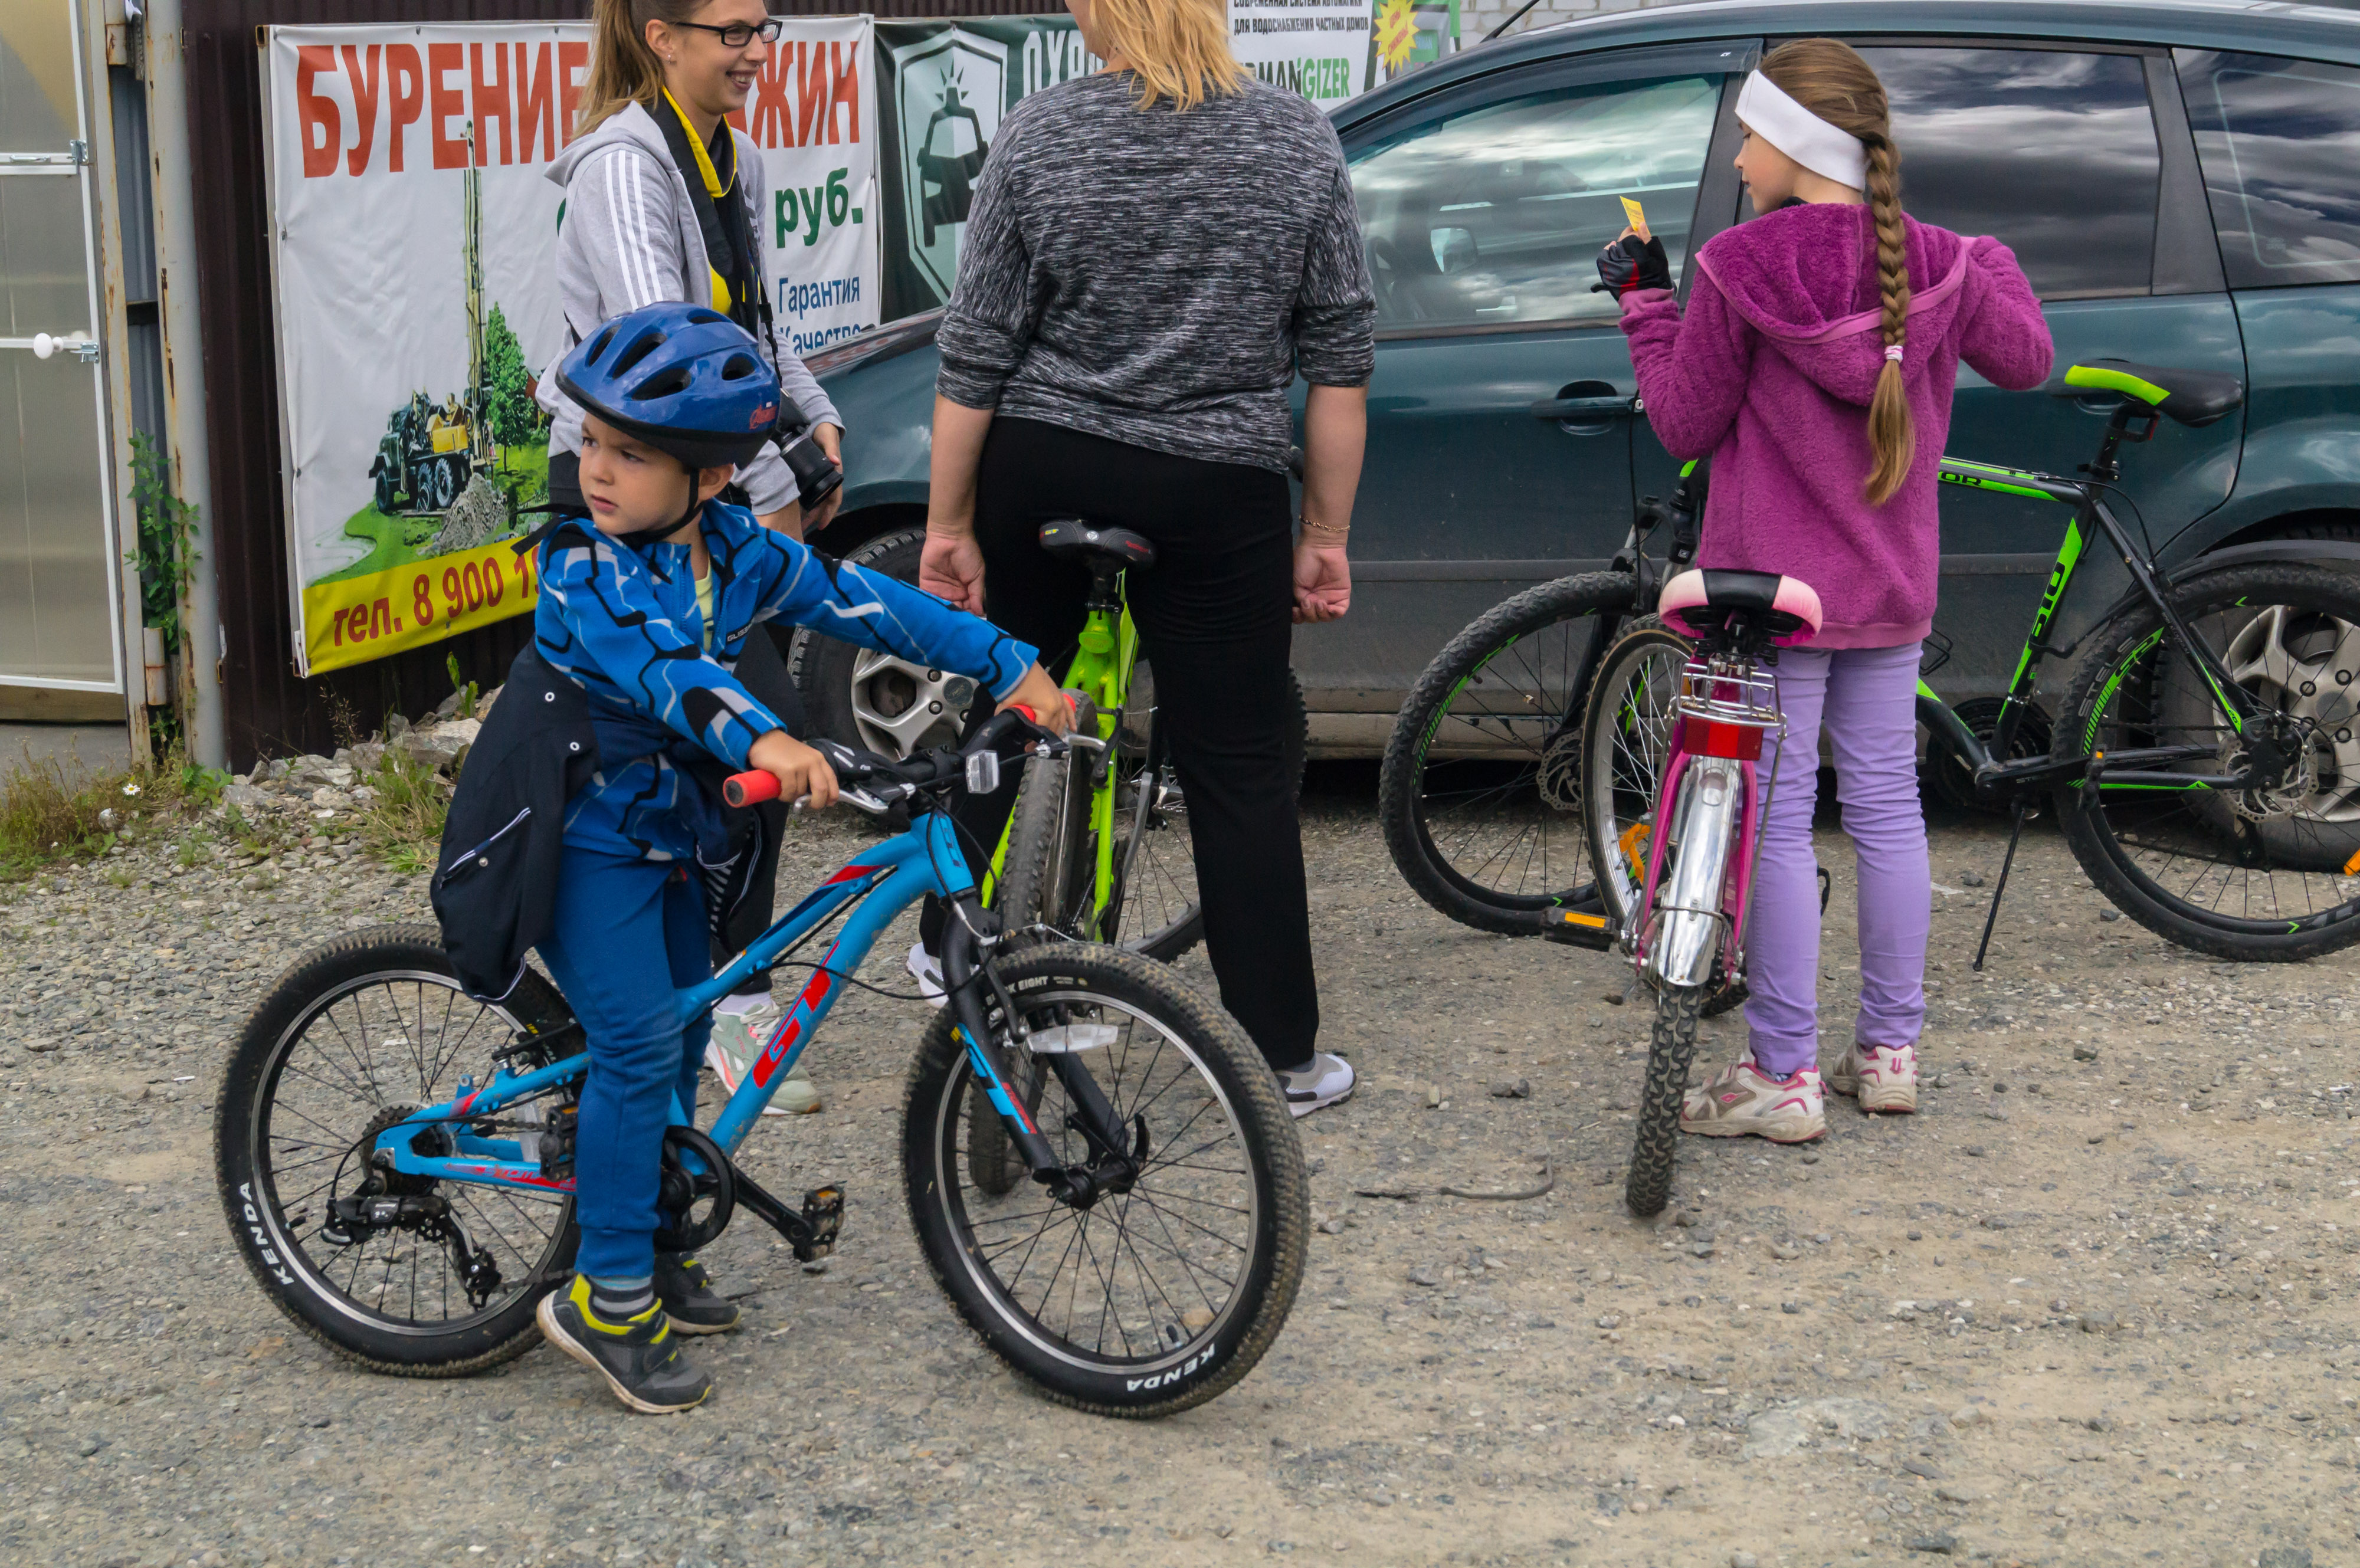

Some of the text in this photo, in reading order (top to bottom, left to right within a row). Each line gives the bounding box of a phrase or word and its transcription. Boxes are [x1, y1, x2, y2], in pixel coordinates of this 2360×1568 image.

[1023, 29, 1104, 99] ОХР
[1234, 17, 1369, 35] ДЛЯ ВОДОСНАБЖЕНИЯ ЧАСТНЫХ ДОМОВ
[296, 41, 589, 178] БУРЕНИЕ
[729, 40, 860, 149] ЖИН
[775, 168, 863, 249] руб.
[779, 276, 860, 320] Гарантия
[333, 597, 404, 647] тел.
[413, 574, 434, 626] 8
[442, 556, 504, 619] 900
[2077, 635, 2136, 720] STELS
[1018, 976, 1048, 991] EIGHT
[237, 1181, 295, 1286] KENDA
[1126, 1343, 1216, 1392] KENDA
